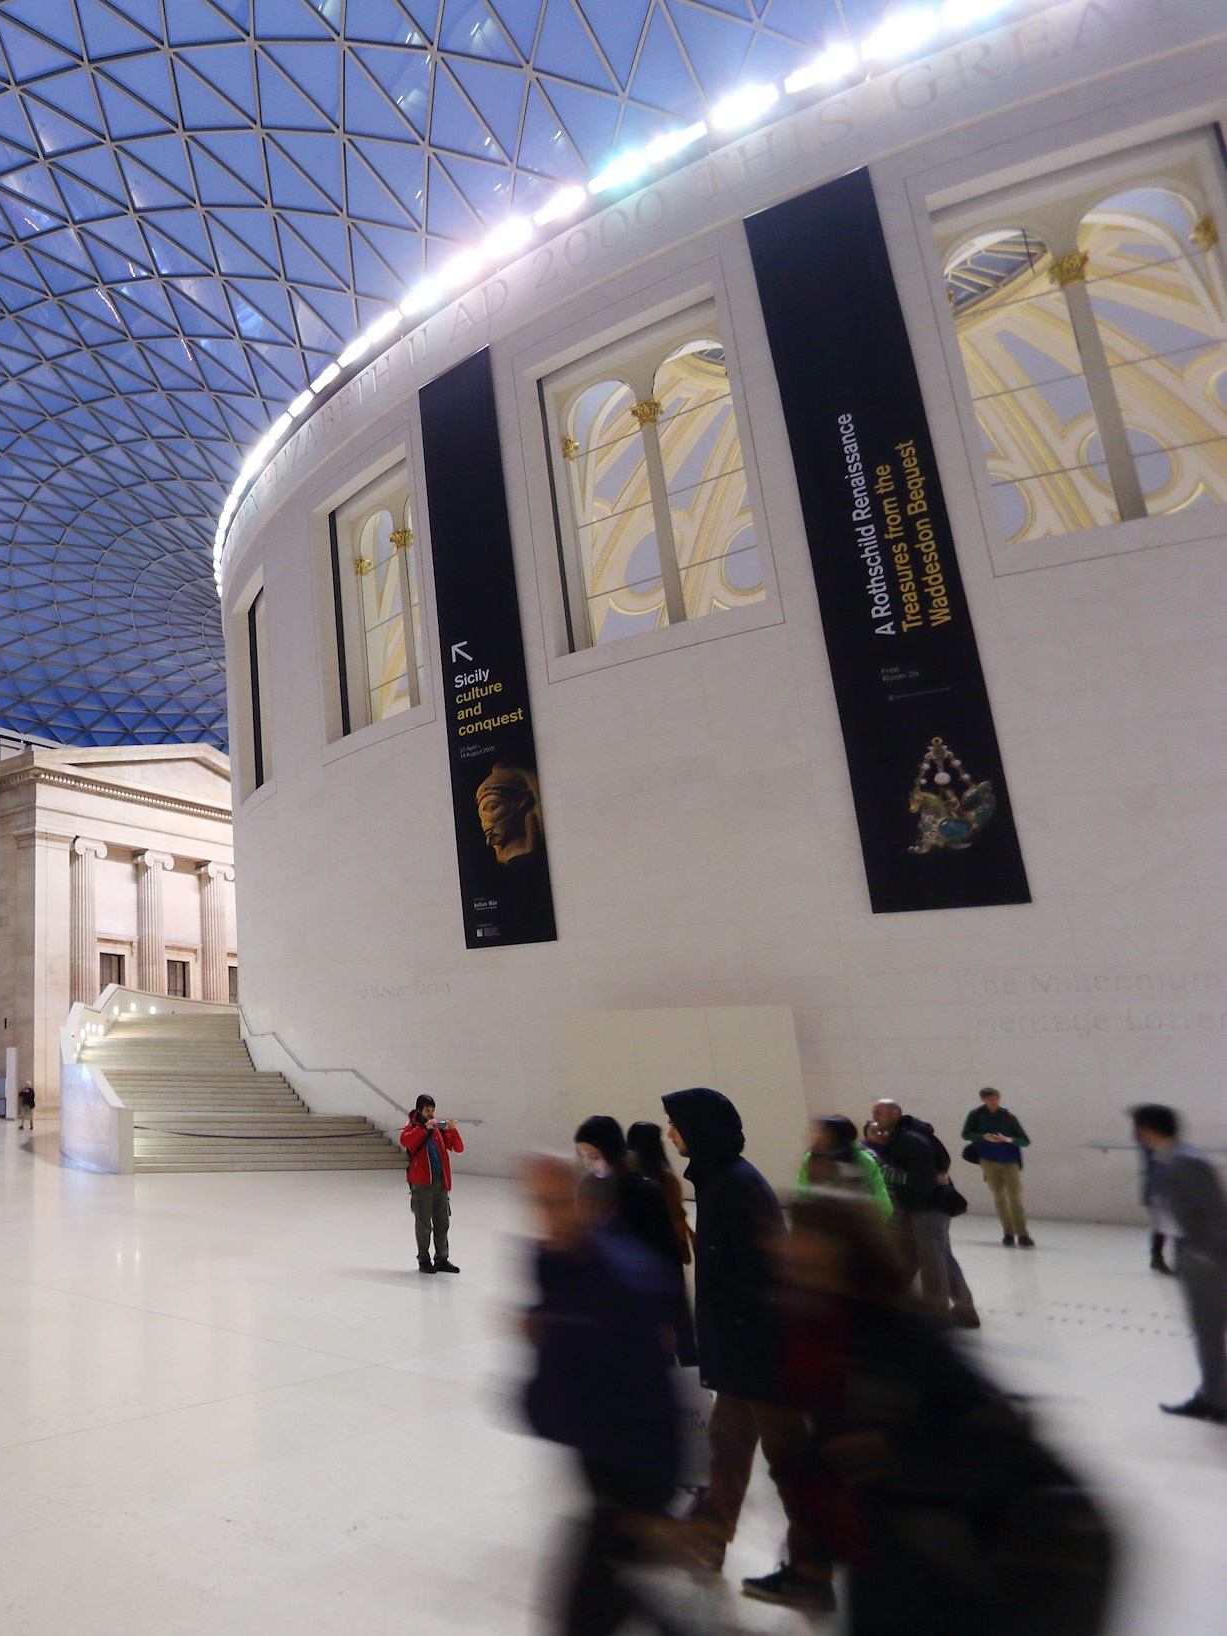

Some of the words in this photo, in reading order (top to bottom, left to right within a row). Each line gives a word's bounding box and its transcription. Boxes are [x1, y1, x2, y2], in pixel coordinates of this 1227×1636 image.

[448, 279, 509, 343] AD
[532, 189, 666, 289] 2000
[692, 98, 855, 201] THIS
[838, 412, 872, 522] Renaissance
[874, 463, 895, 495] the
[895, 439, 928, 516] Bequest
[884, 496, 905, 540] from
[855, 524, 892, 619] Rothschild
[892, 542, 923, 632] Treasures
[915, 517, 952, 627] Waddesdon
[875, 621, 896, 636] A
[454, 668, 490, 689] Sicily
[455, 682, 503, 704] culture
[882, 673, 907, 682] Room
[457, 701, 482, 721] and
[458, 707, 524, 737] conquest
[1031, 969, 1222, 993] Millennium
[975, 1009, 1110, 1039] Heritage
